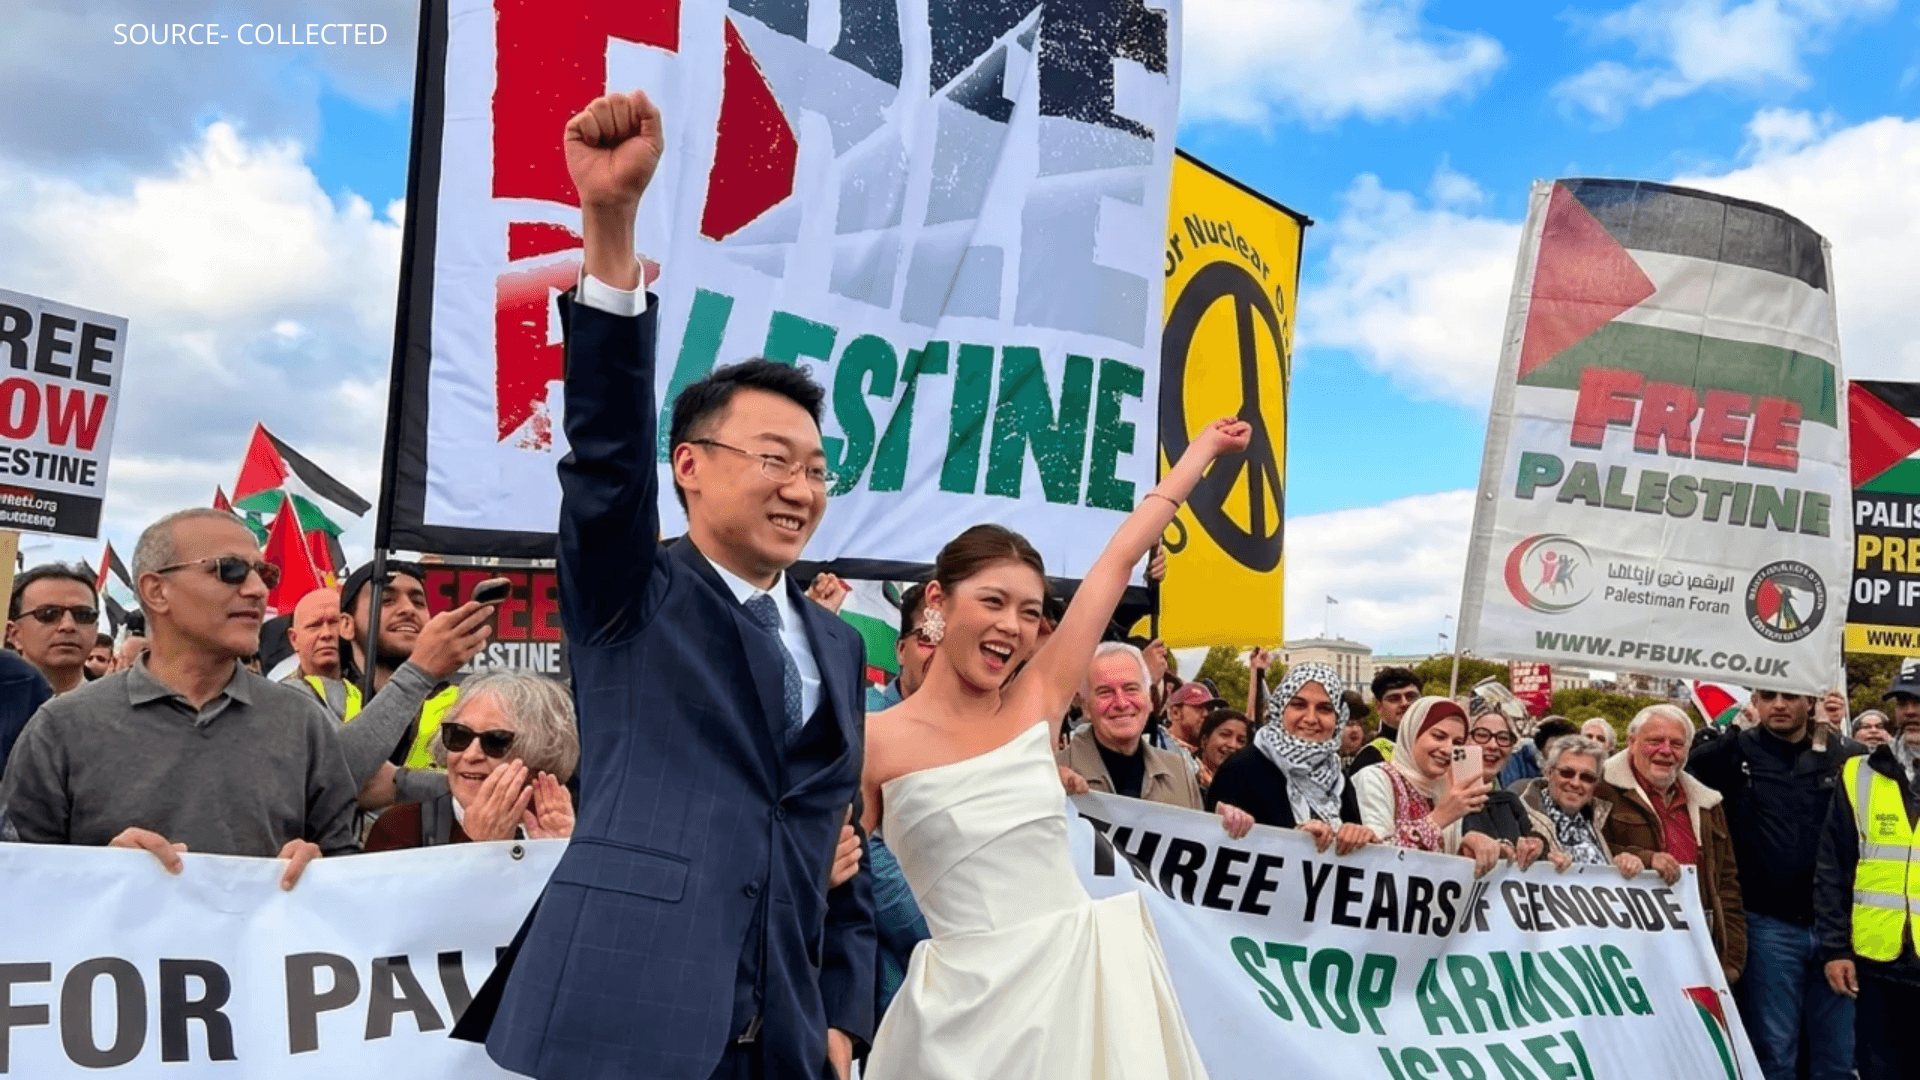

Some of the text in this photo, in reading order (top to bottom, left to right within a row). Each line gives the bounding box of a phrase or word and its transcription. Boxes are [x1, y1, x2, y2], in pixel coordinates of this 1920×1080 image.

[1184, 213, 1270, 281] Nuclear
[0, 303, 117, 387] REE
[0, 377, 109, 452] OW
[1569, 365, 1803, 473] FREE
[1515, 451, 1832, 538] PALESTINE
[1854, 577, 1891, 605] OP
[1535, 631, 1792, 678] WWW.PFBUK.CO.UK
[1079, 812, 1284, 916] THREE
[1302, 859, 1462, 938] YEARS
[1500, 880, 1691, 932] GENOCIDE
[0, 956, 238, 1074] FOR
[1230, 936, 1656, 1036] STOP ARMING
